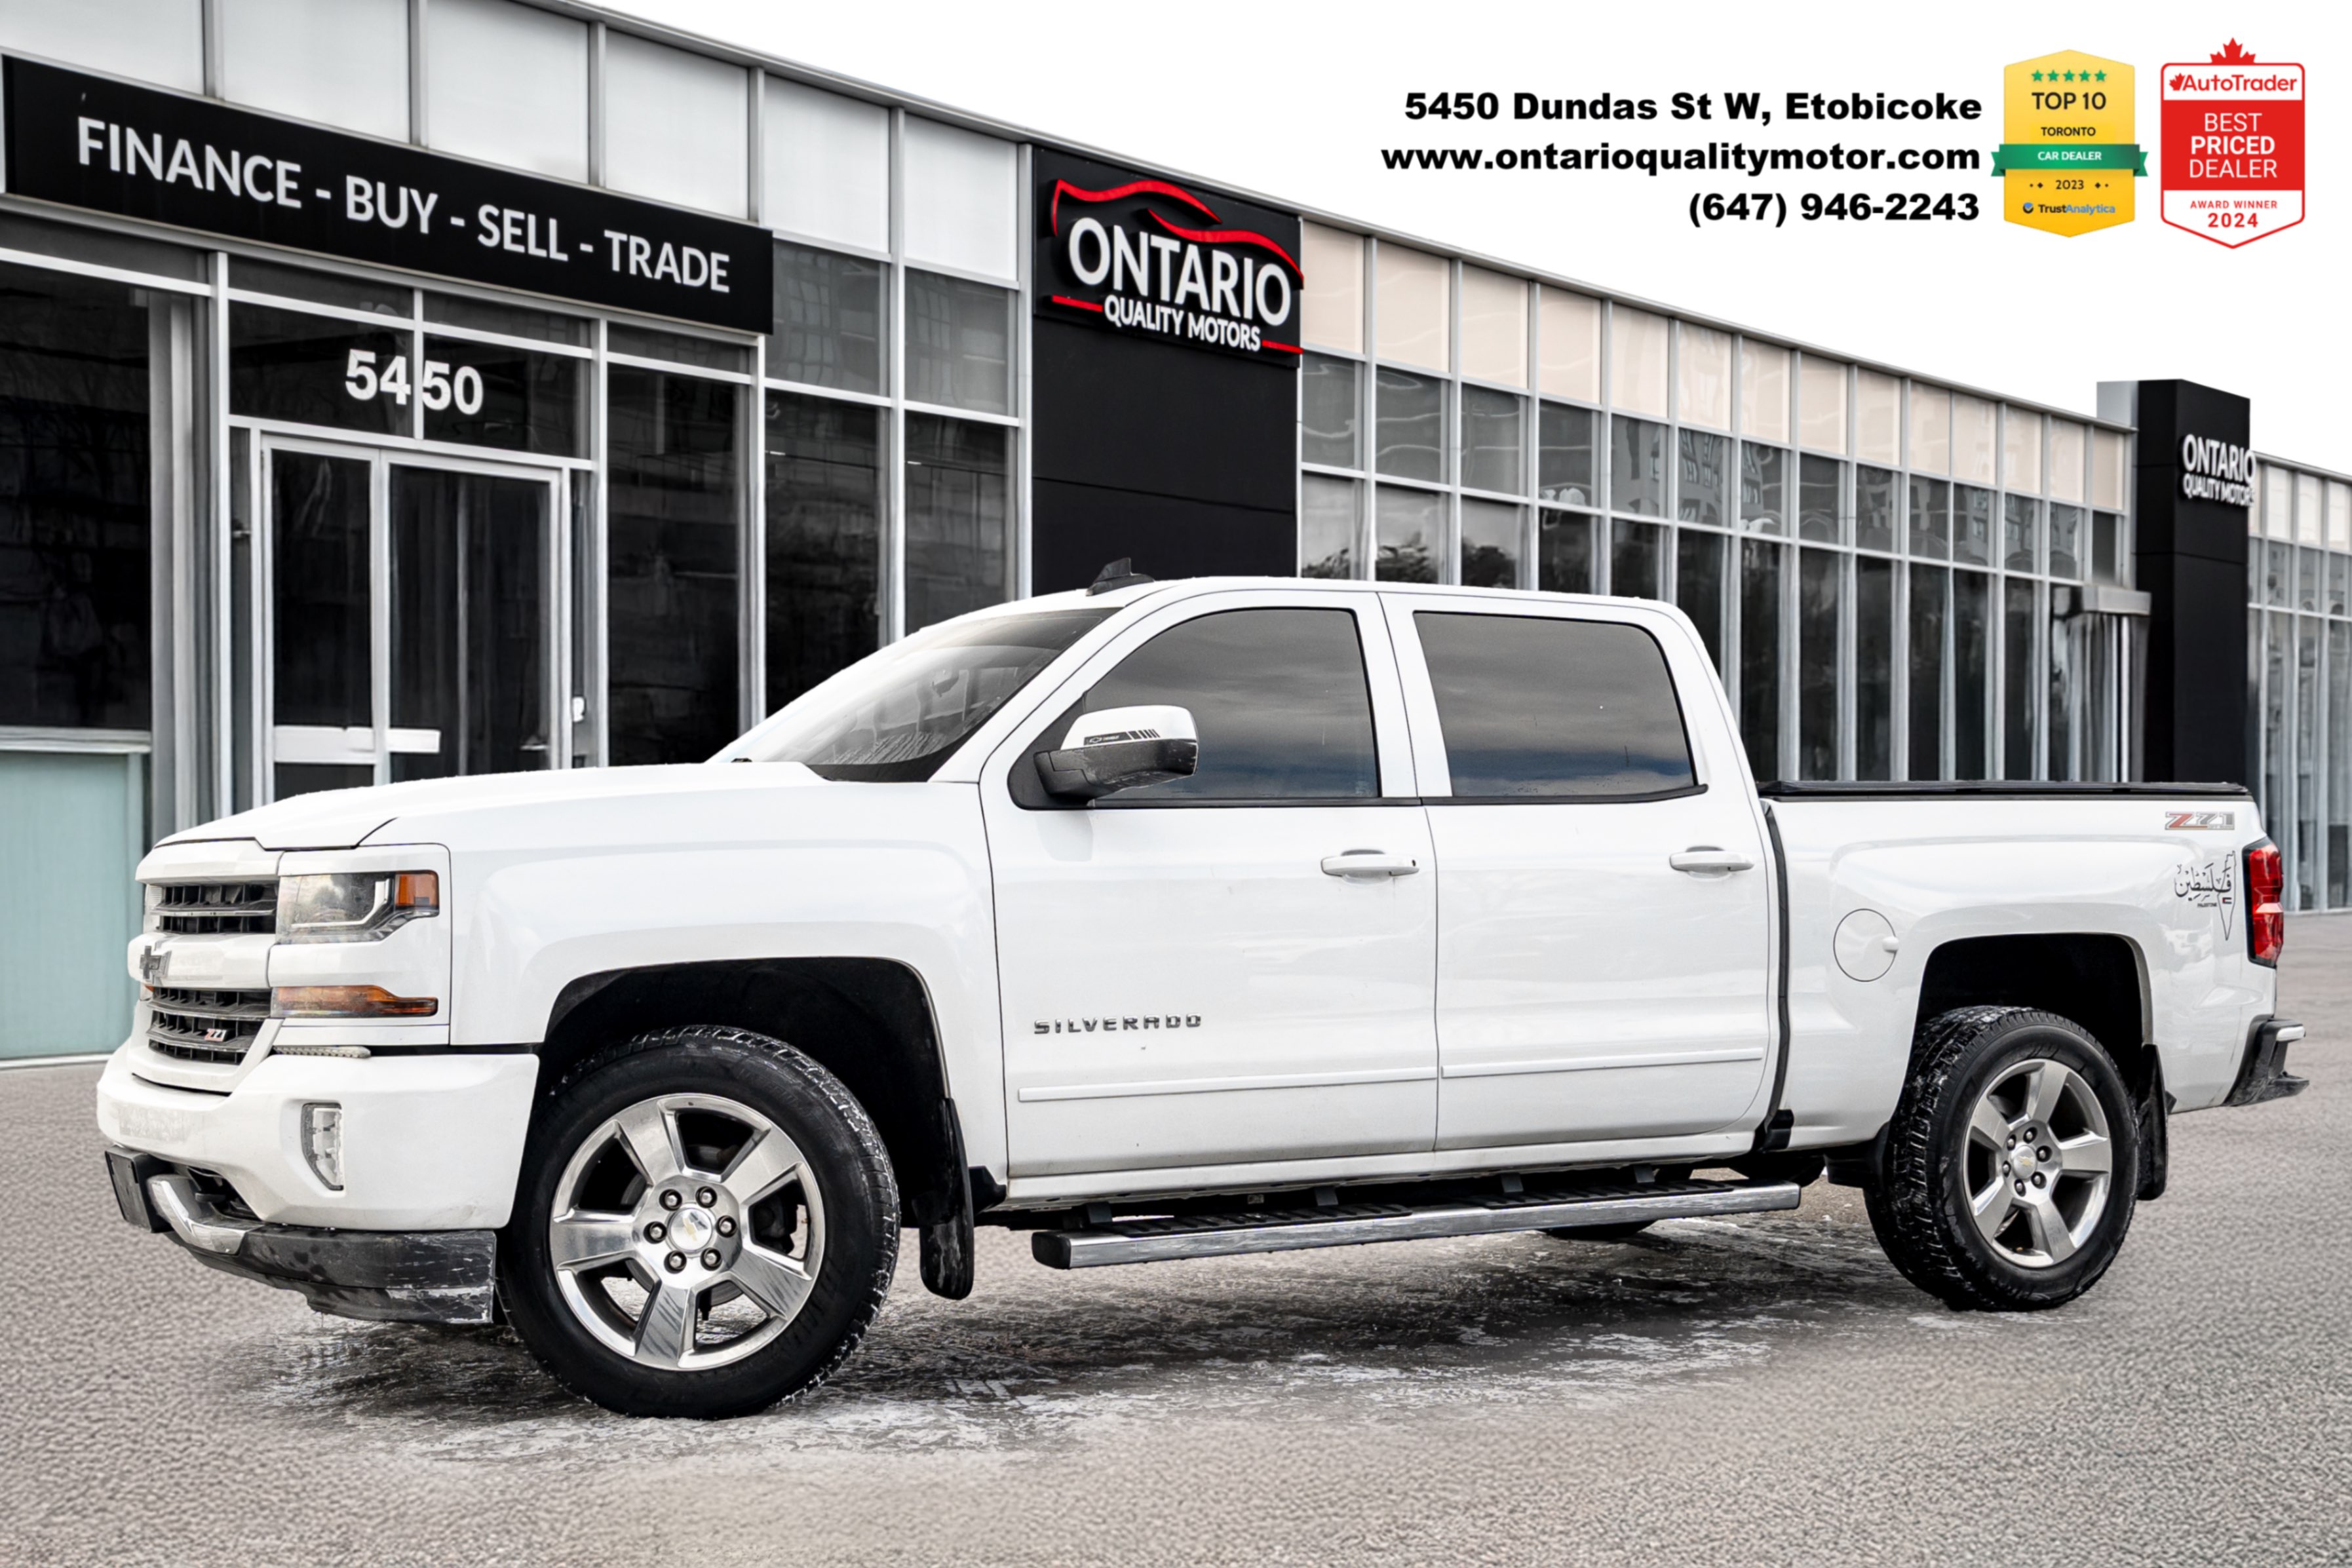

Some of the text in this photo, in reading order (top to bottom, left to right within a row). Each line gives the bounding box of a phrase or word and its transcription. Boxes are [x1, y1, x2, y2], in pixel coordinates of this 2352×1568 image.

[77, 116, 302, 208] FINANCE
[345, 174, 438, 235] BUY
[477, 204, 569, 261] SELL
[604, 229, 730, 293] TRADE
[1069, 217, 1292, 326] ONTARIO
[1104, 294, 1262, 352] QUALITY MOTORS
[345, 348, 484, 415] 5450
[2183, 433, 2256, 485] ONTARIO
[2183, 472, 2221, 499] QUALITY
[2165, 812, 2235, 830] Z71
[204, 1028, 227, 1042] Z71
[1033, 1013, 1201, 1035] SILVERADO
